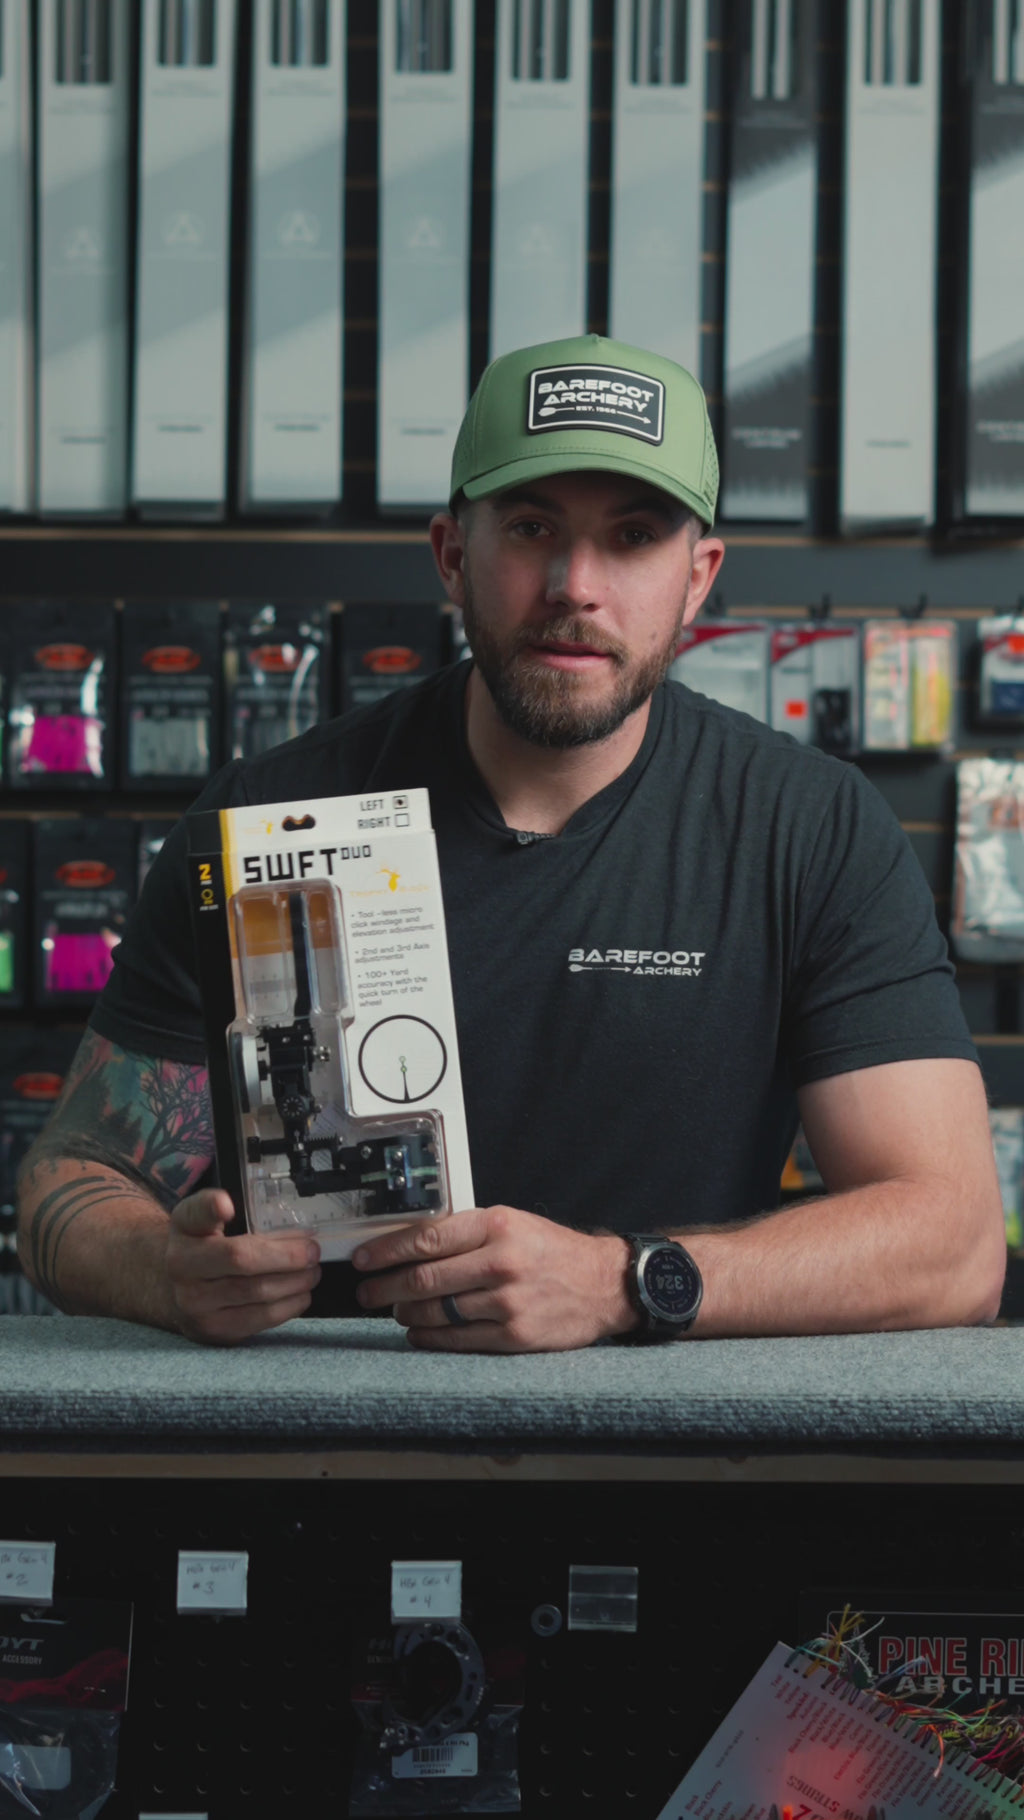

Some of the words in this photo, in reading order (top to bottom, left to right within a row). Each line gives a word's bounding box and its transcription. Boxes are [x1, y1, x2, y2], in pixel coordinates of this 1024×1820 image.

[538, 379, 654, 402] BAREFOOT
[543, 391, 648, 412] ARCHERY
[360, 798, 384, 811] LEFT
[357, 816, 391, 830] RIGHT
[198, 863, 211, 880] 2
[243, 848, 337, 884] SWFT
[340, 845, 372, 861] DUO
[399, 906, 423, 914] micro
[351, 920, 369, 929] click
[405, 915, 420, 923] and
[352, 929, 388, 938] elevation
[389, 923, 435, 935] adjustment
[362, 948, 378, 956] 2nd
[380, 946, 395, 954] and
[396, 944, 411, 952] 3rd
[567, 948, 706, 966] BAREFOOT
[390, 967, 409, 976] Yard
[633, 966, 702, 977] ARCHERY
[357, 980, 393, 990] accuracy
[395, 977, 413, 986] with
[409, 984, 424, 993] the
[2, 1653, 43, 1665] ACCESSORY
[878, 1636, 968, 1676] PINE
[980, 1637, 1024, 1678] RI
